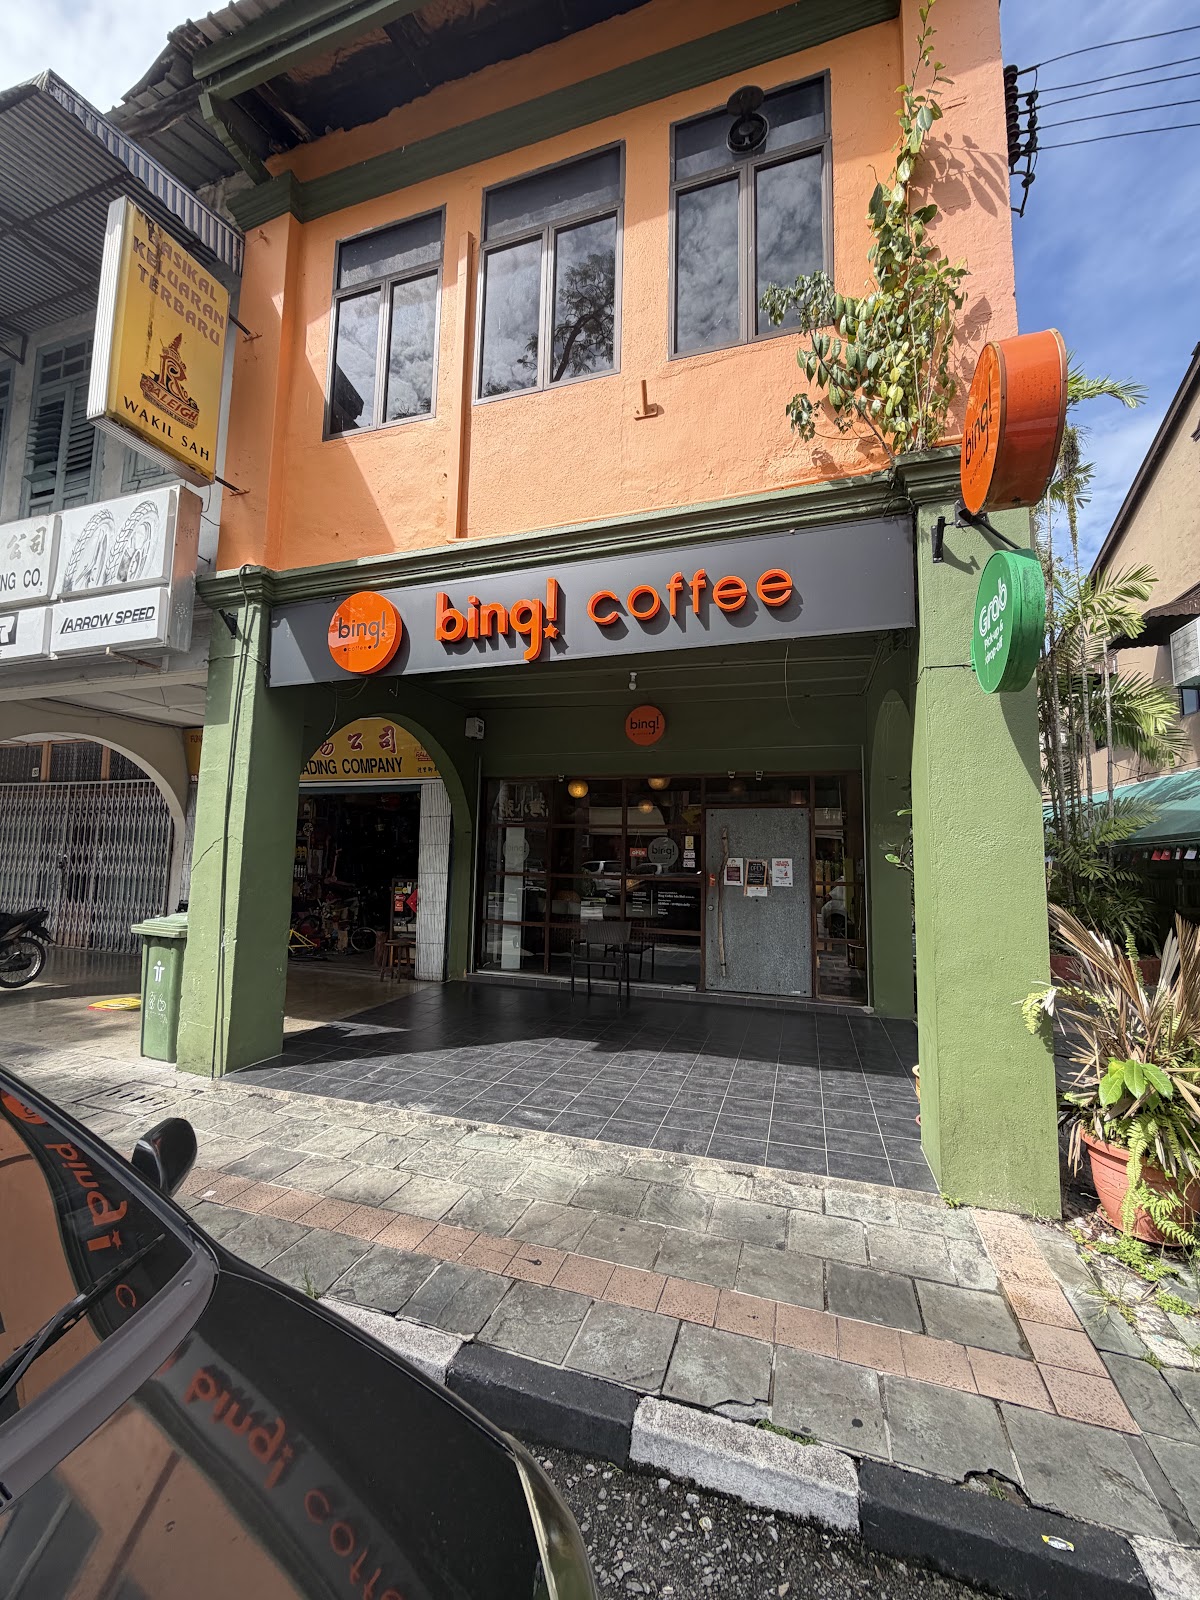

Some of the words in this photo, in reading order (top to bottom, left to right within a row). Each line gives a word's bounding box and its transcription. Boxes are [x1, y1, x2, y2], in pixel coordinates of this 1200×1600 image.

[133, 235, 224, 329] KELUARAN
[138, 263, 220, 346] TERBARU
[140, 379, 198, 422] RALEIGH
[124, 395, 173, 439] WAKIL
[181, 435, 209, 461] SAH
[966, 374, 992, 469] bing!
[7, 526, 47, 560] 公司
[23, 568, 43, 588] CO.
[115, 606, 155, 625] SPEED
[434, 578, 559, 662] bing!
[587, 567, 794, 626] coffee
[979, 577, 1007, 637] Grab
[338, 611, 386, 649] bing!
[630, 715, 660, 734] bing!
[342, 757, 403, 774] COMPANY
[652, 844, 675, 859] bing!
